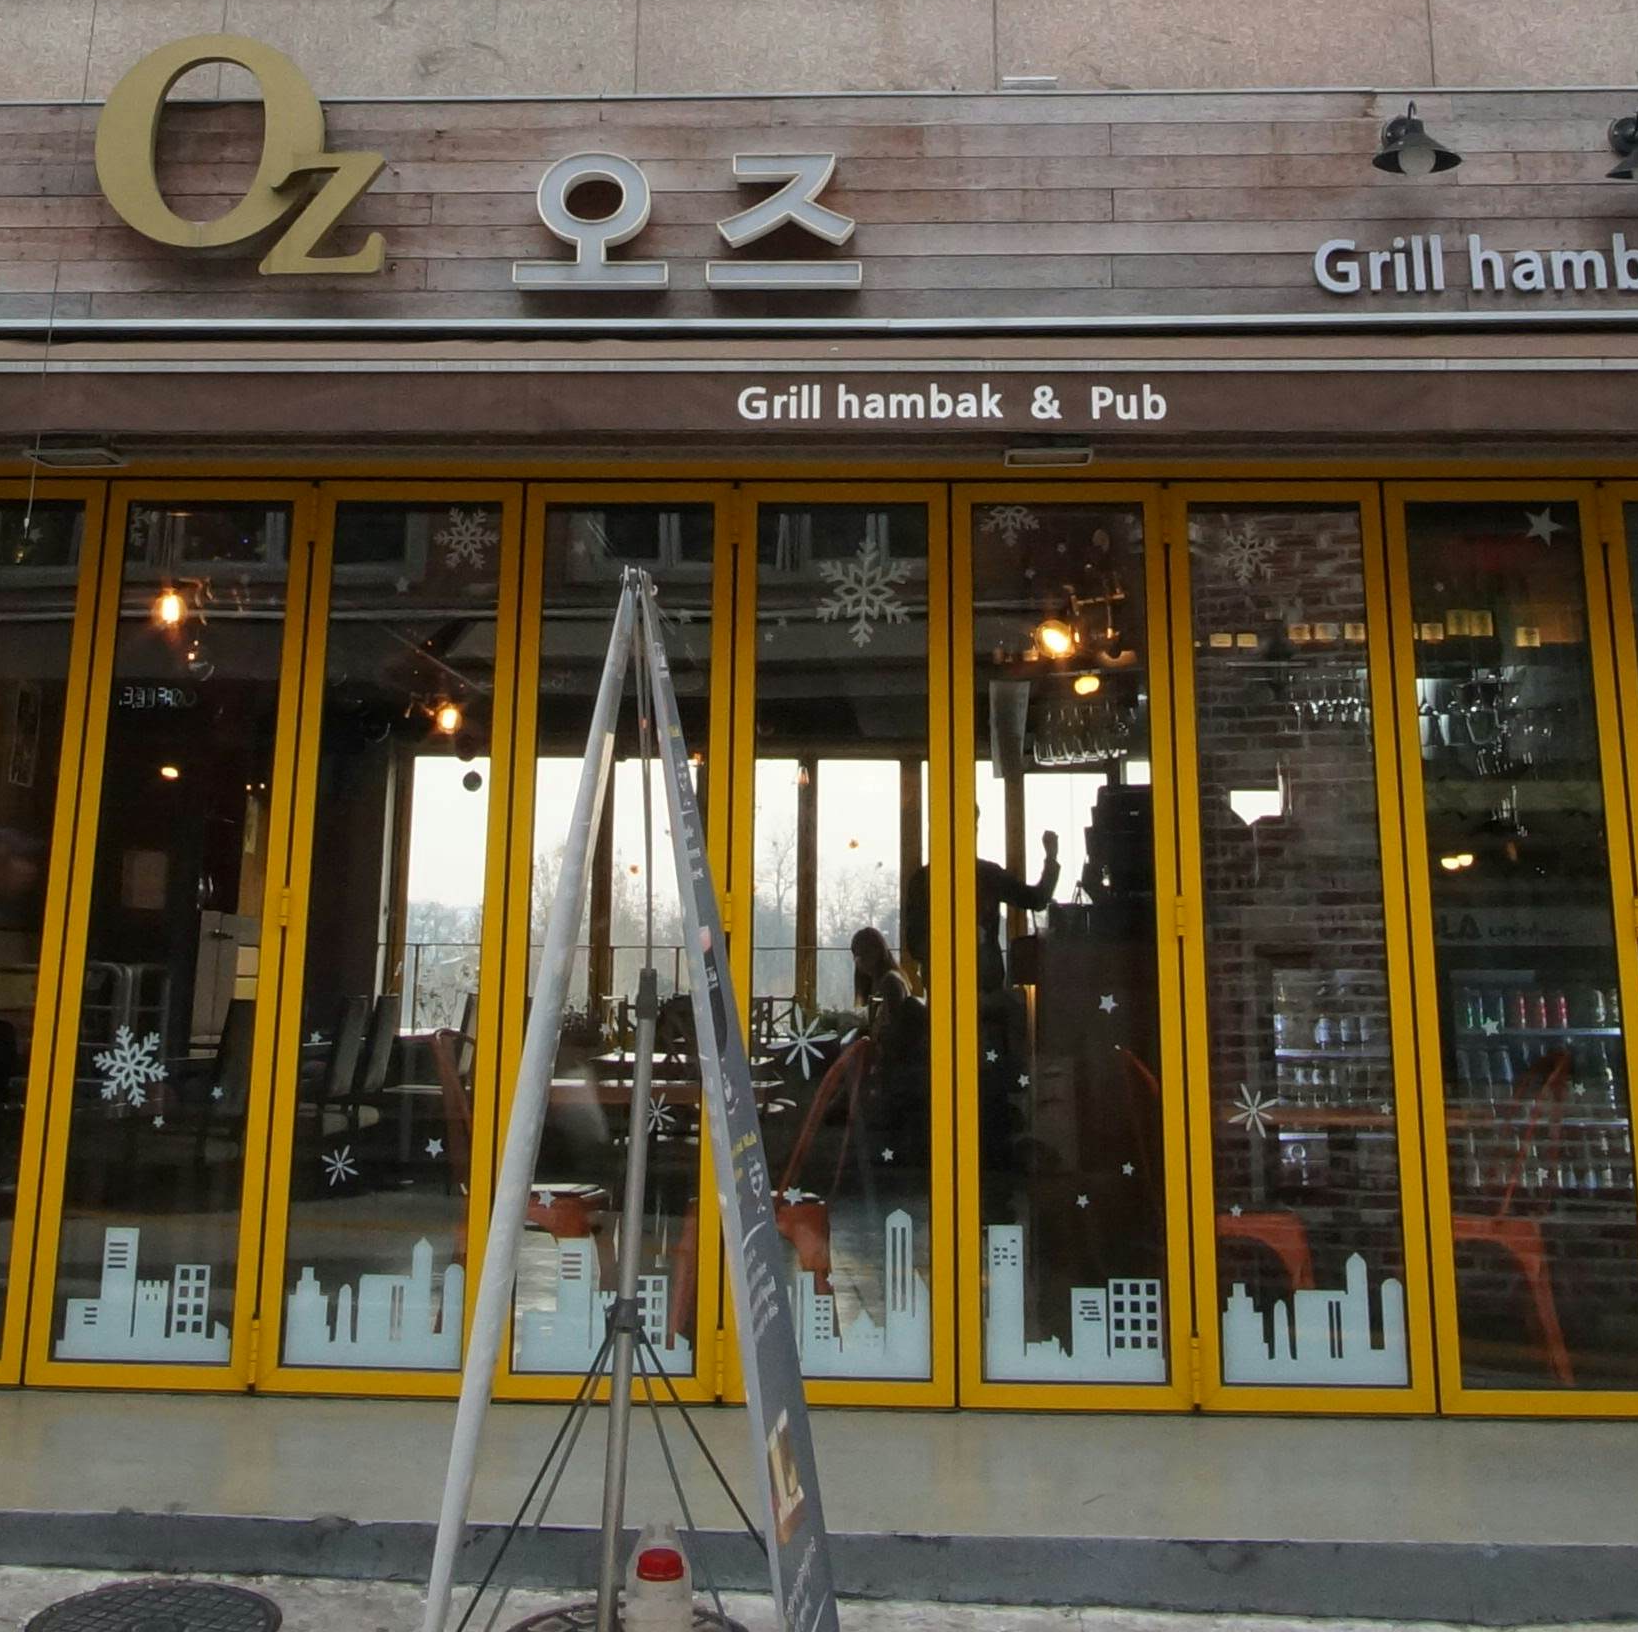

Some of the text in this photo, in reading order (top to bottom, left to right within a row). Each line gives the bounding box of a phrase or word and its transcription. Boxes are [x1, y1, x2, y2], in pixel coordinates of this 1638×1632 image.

[511, 148, 864, 290] 오즈
[1312, 234, 1445, 294] Grill
[737, 383, 1167, 420] Grill hambak & Pub
